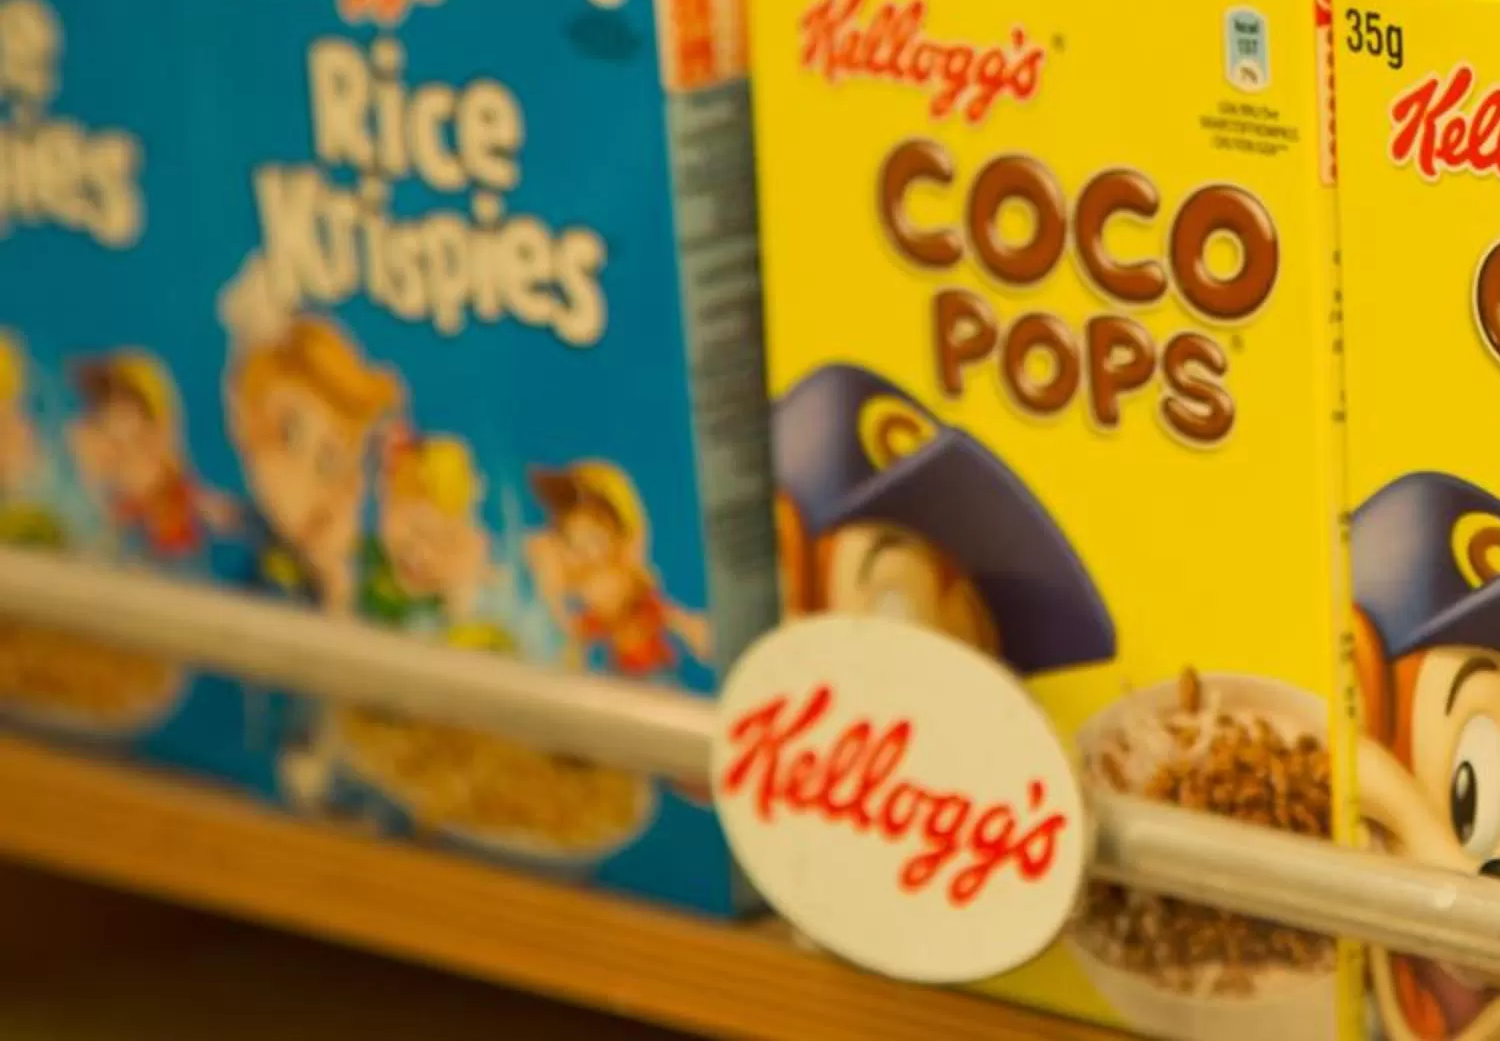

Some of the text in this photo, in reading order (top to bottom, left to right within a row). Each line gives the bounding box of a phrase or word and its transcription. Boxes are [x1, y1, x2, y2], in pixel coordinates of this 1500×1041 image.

[309, 37, 522, 188] Rice
[1345, 8, 1404, 68] 35g
[256, 167, 606, 345] Krispies
[877, 135, 1279, 321] COCO
[933, 289, 1235, 443] POPS
[721, 683, 1067, 909] Kellogg's
